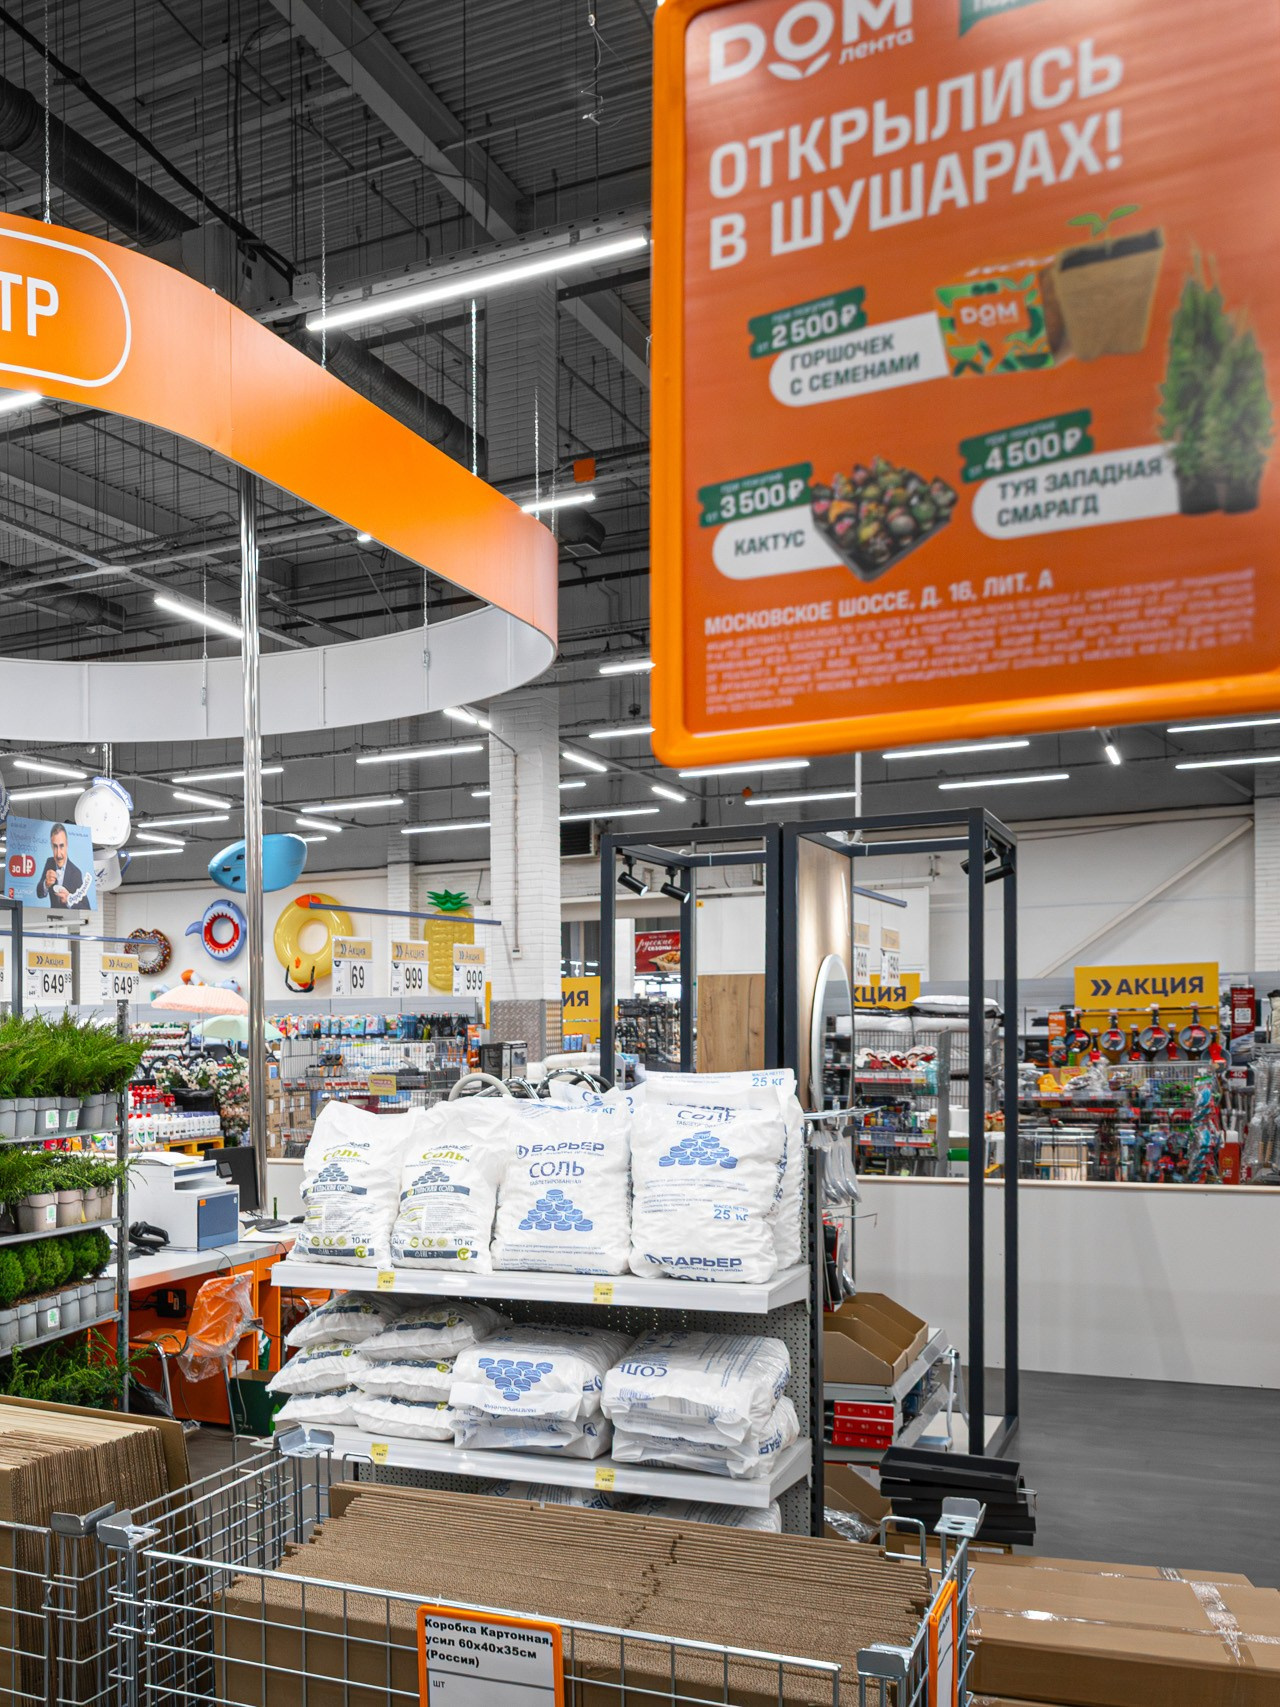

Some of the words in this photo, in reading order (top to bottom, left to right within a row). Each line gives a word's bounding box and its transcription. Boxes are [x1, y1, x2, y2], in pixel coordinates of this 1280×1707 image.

[709, 0, 913, 85] DOM
[838, 28, 914, 65] лента
[709, 37, 1124, 199] ОТКРЫЛИСЬ
[710, 212, 747, 270] В
[770, 107, 1123, 257] ШУШАРАХ!
[790, 334, 895, 372] ГОРШОЧЕК
[790, 378, 802, 396] С
[809, 352, 920, 392] СЕМЕНАМИ
[998, 477, 1037, 501] ТУЯ
[1044, 457, 1162, 492] ЗАПАДНАЯ
[997, 494, 1099, 527] СМАРАГД
[734, 530, 805, 557] КАКТУС
[704, 600, 833, 636] МОСКОВСКОЕ
[1037, 568, 1054, 590] А
[44, 956, 65, 966] Акция
[348, 946, 366, 956] Акция
[405, 946, 425, 959] Акция
[116, 961, 133, 969] Акция
[43, 974, 64, 994] 649
[114, 976, 133, 995] 649
[352, 966, 364, 989] 69
[405, 967, 422, 989] 999
[466, 970, 483, 990] 999
[1115, 976, 1204, 997] АКЦИЯ
[854, 986, 907, 1005] КЦИЯ
[752, 1077, 767, 1087] 25
[531, 1142, 605, 1153] БАРЬЕР
[529, 1160, 585, 1178] СОЛЬ
[713, 1209, 731, 1220] 25
[453, 1238, 462, 1246] 10
[424, 1618, 477, 1634] Коробка
[480, 1626, 554, 1648] Картонная,
[425, 1635, 455, 1647] усил
[426, 1648, 480, 1668] (Россия)
